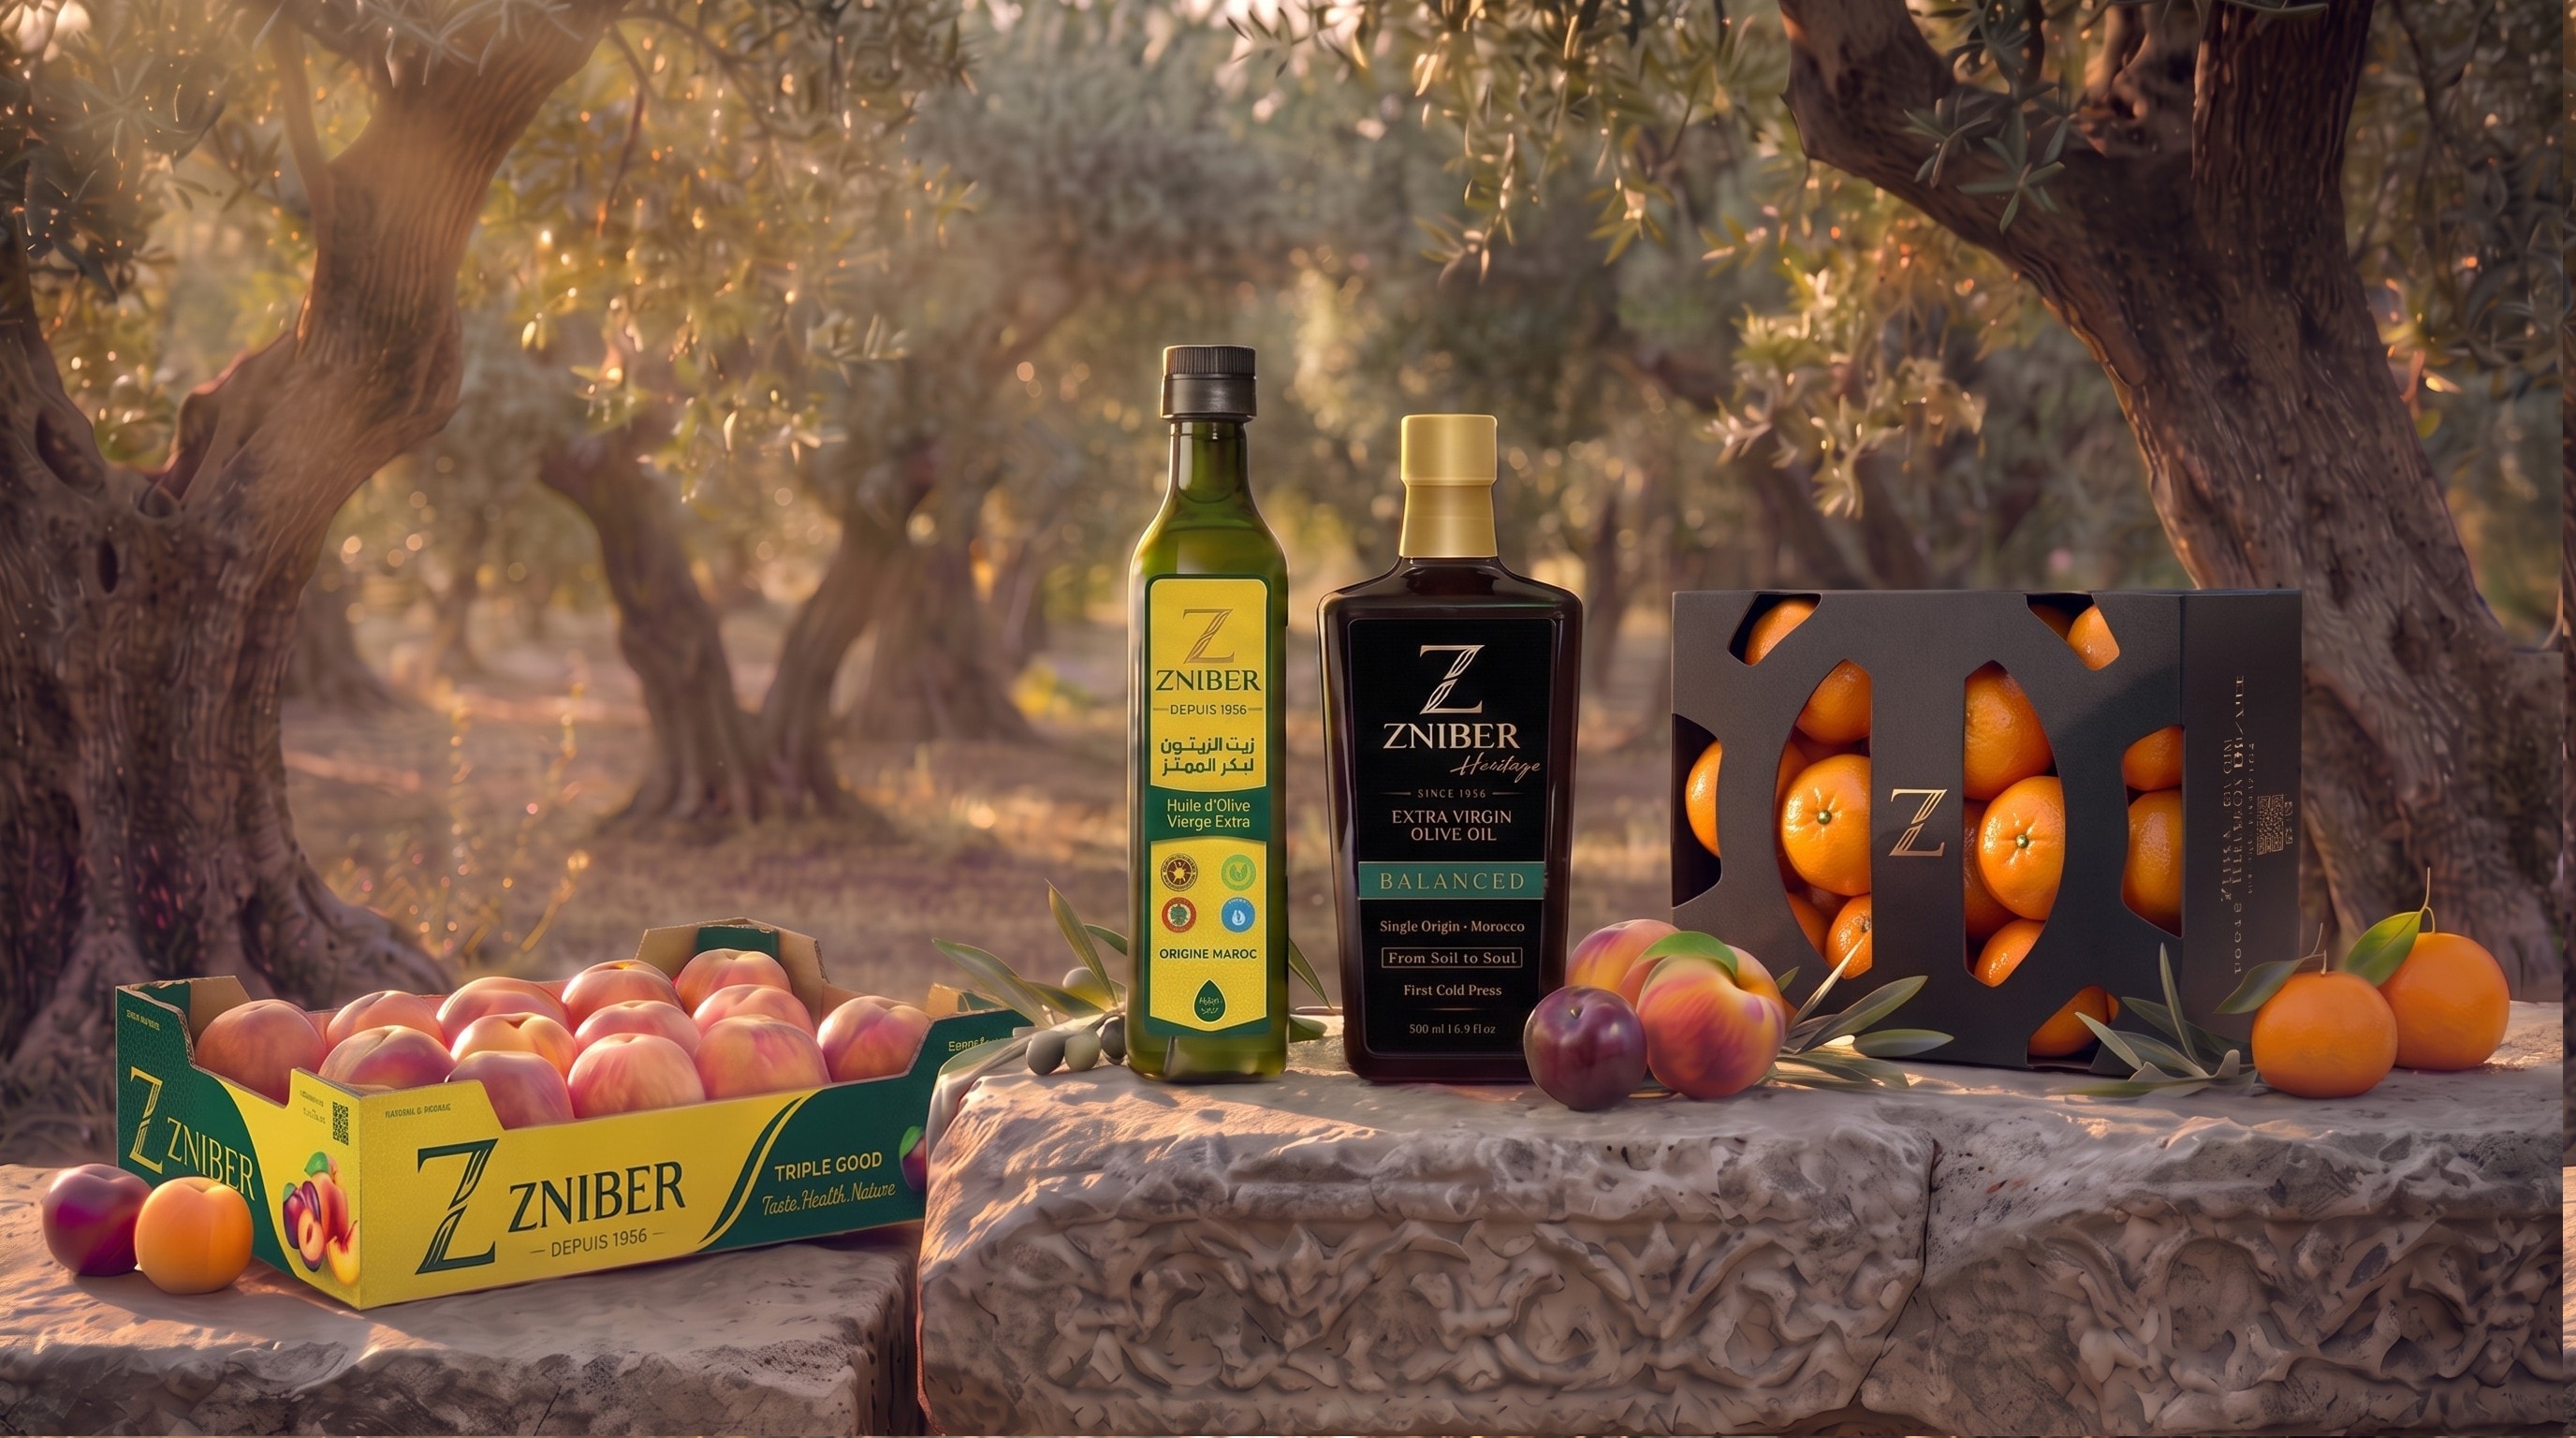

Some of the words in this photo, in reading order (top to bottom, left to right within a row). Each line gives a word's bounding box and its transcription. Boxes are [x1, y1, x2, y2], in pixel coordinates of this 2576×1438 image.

[1155, 669, 1261, 692] ZNIBER
[1170, 704, 1217, 715] DEPUIS
[1221, 704, 1247, 715] 1956
[1383, 723, 1521, 749] ZNIBER
[1450, 751, 1541, 784] Heritage
[1417, 788, 1455, 799] SINCE
[1459, 788, 1486, 799] 1956
[1166, 799, 1201, 813] Huile
[1204, 799, 1251, 813] d'Olive
[1166, 814, 1211, 831] Vierge
[1215, 814, 1251, 829] Extra
[1392, 810, 1448, 824] EXTRA
[1453, 810, 1512, 824] VIRGIN
[1411, 828, 1462, 841] OLIVE
[1467, 828, 1497, 841] OIL
[1380, 873, 1525, 889] BALANCED
[1380, 920, 1418, 934] Single
[1421, 920, 1460, 934] Origin
[1471, 920, 1525, 932] Morocco
[1159, 948, 1209, 960] ORIGINE
[1212, 948, 1257, 960] MAROC
[1388, 952, 1426, 964] From
[1430, 952, 1458, 964] Soil
[1463, 953, 1478, 964] to
[1483, 952, 1517, 964] Soul
[1403, 985, 1433, 996] First
[1436, 985, 1465, 996] Cold
[1468, 985, 1502, 996] Press
[1409, 1023, 1429, 1034] 500
[1431, 1023, 1444, 1034] ml
[167, 1116, 256, 1202] ZNIBER
[774, 1158, 831, 1181] TRIPLE
[835, 1152, 883, 1173] GOOD
[507, 1161, 686, 1233] ZNIBER
[550, 1234, 608, 1257] DEPUIS
[612, 1228, 648, 1248] 1956
